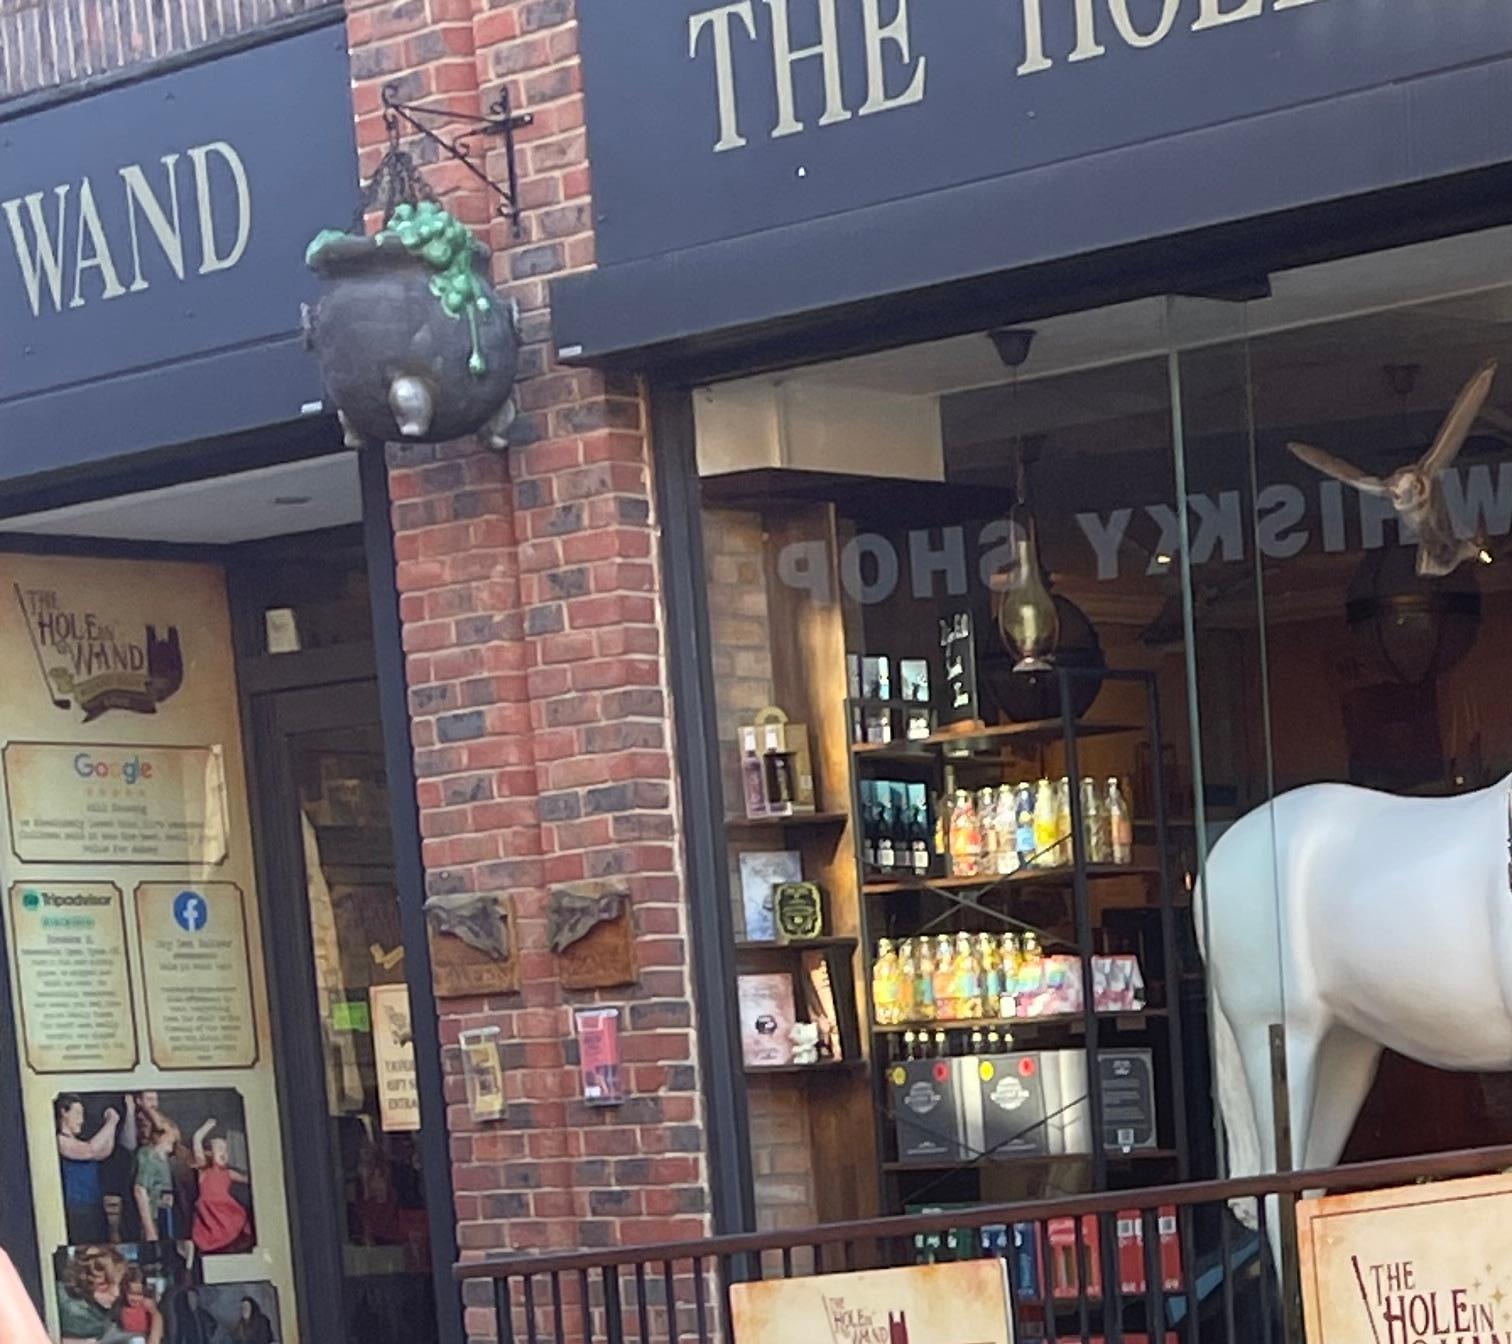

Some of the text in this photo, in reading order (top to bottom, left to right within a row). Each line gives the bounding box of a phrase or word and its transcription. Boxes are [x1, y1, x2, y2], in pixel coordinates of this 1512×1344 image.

[688, 0, 926, 152] THE
[2, 141, 251, 317] WAND
[38, 612, 98, 646] HOLE
[57, 640, 145, 676] WAND
[74, 753, 153, 785] Google
[41, 892, 113, 908] Tripadvisor
[1370, 1260, 1416, 1307] THE
[1471, 1303, 1496, 1333] IN
